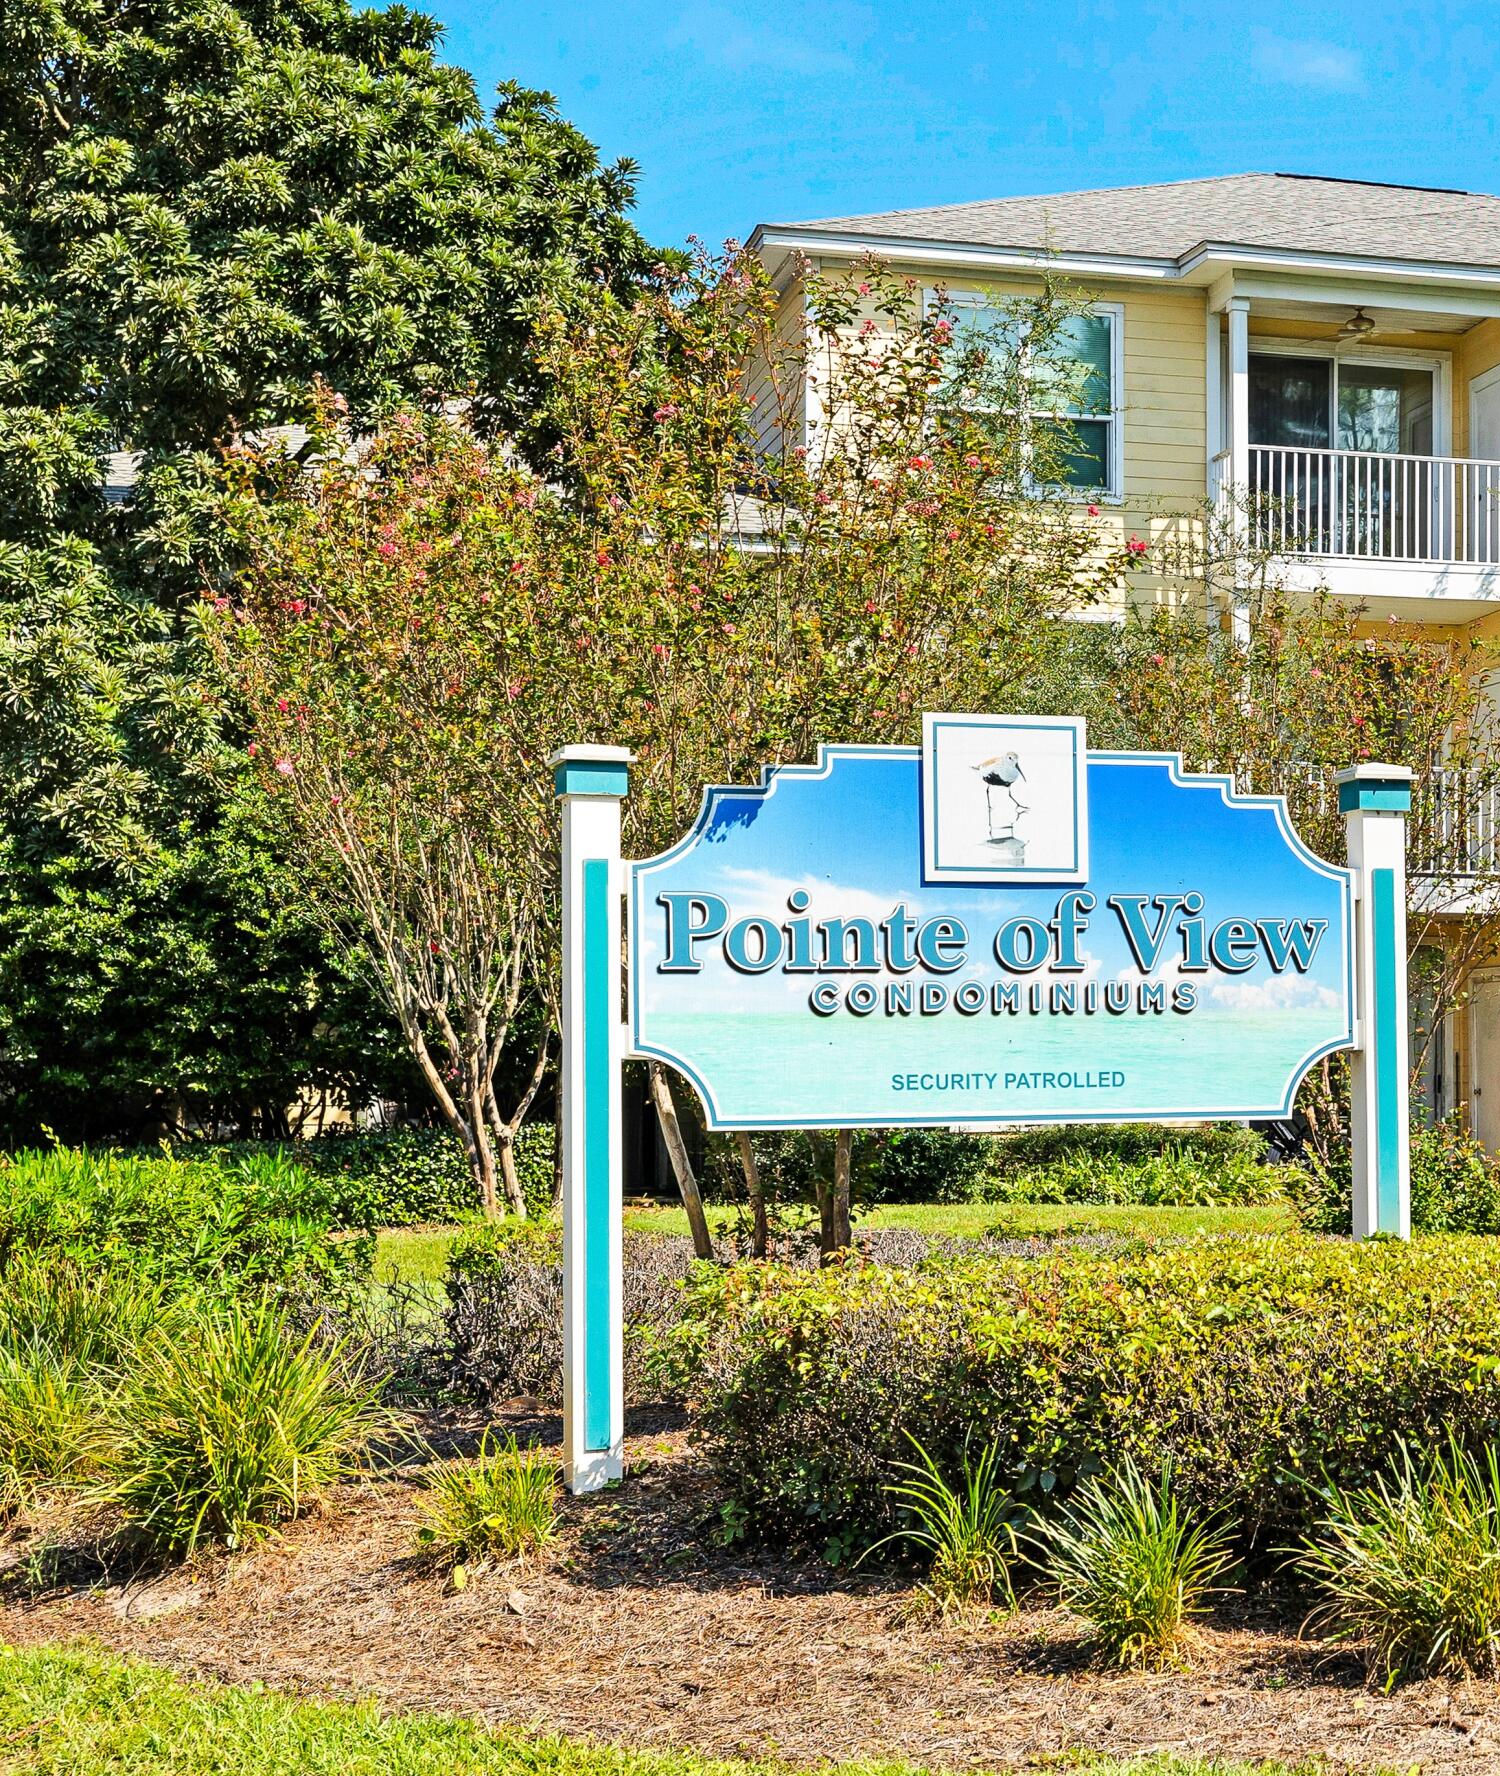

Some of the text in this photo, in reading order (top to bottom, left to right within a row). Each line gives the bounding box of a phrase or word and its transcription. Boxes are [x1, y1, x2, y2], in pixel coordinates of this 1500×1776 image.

[657, 888, 1329, 974] Pointe of View
[808, 979, 1199, 1016] CONDOMINIUMS
[891, 1071, 1126, 1091] SECURITY PATROLLED
